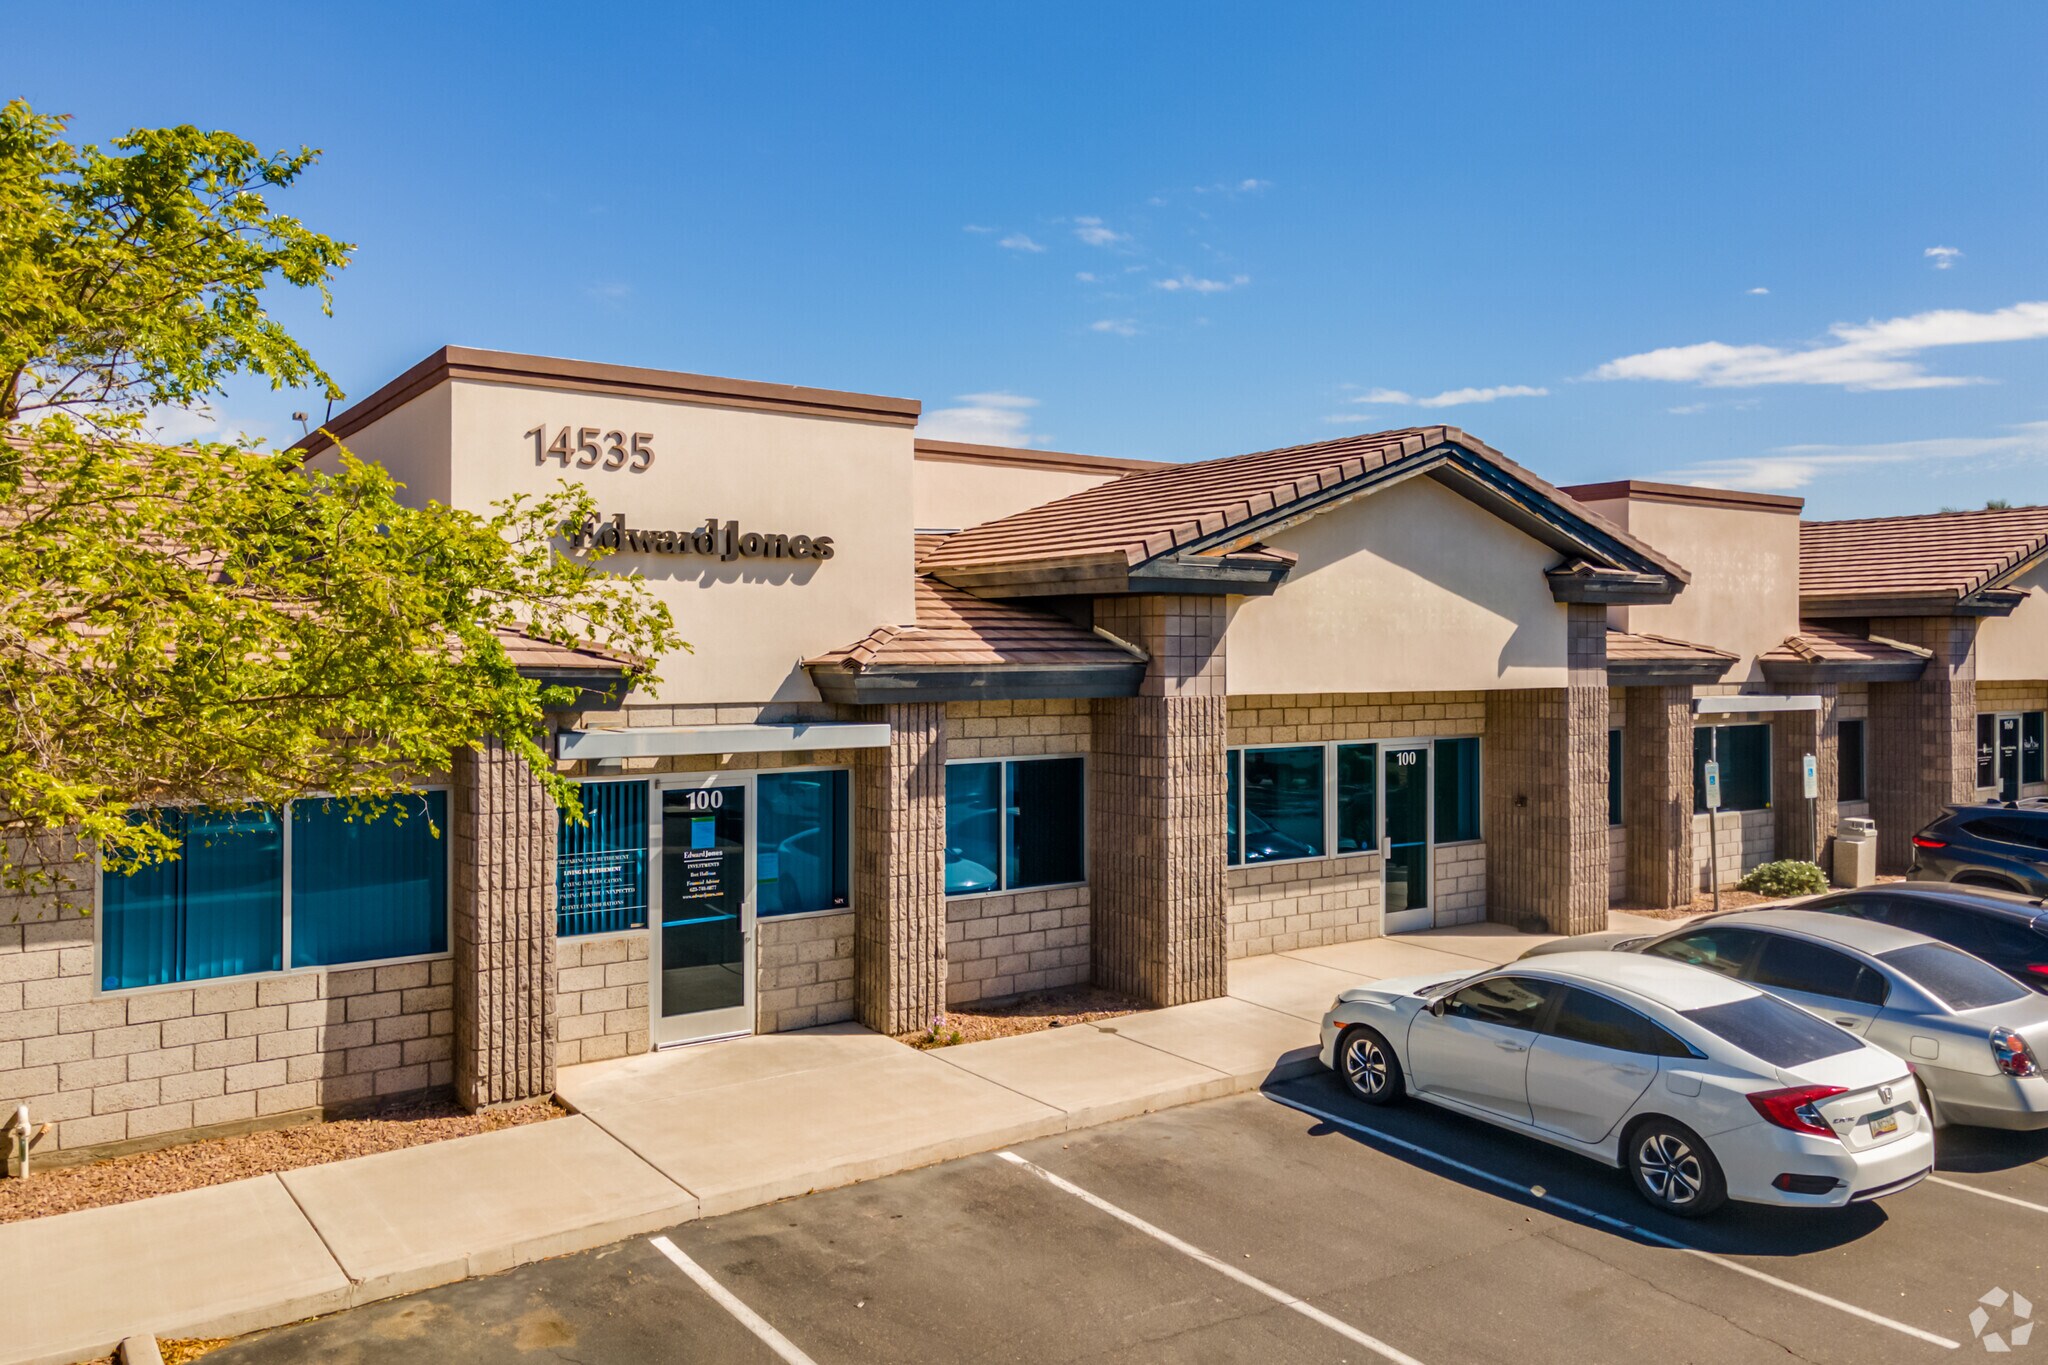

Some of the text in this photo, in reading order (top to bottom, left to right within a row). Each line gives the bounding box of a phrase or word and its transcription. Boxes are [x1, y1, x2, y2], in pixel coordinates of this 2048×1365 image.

[527, 423, 655, 471] 14535
[1396, 751, 1416, 766] 100
[685, 790, 723, 810] 100
[558, 858, 584, 866] REPARING
[597, 854, 630, 862] RETIREMENT
[589, 866, 622, 874] RETIREMENT
[593, 877, 622, 885] EDUCATION
